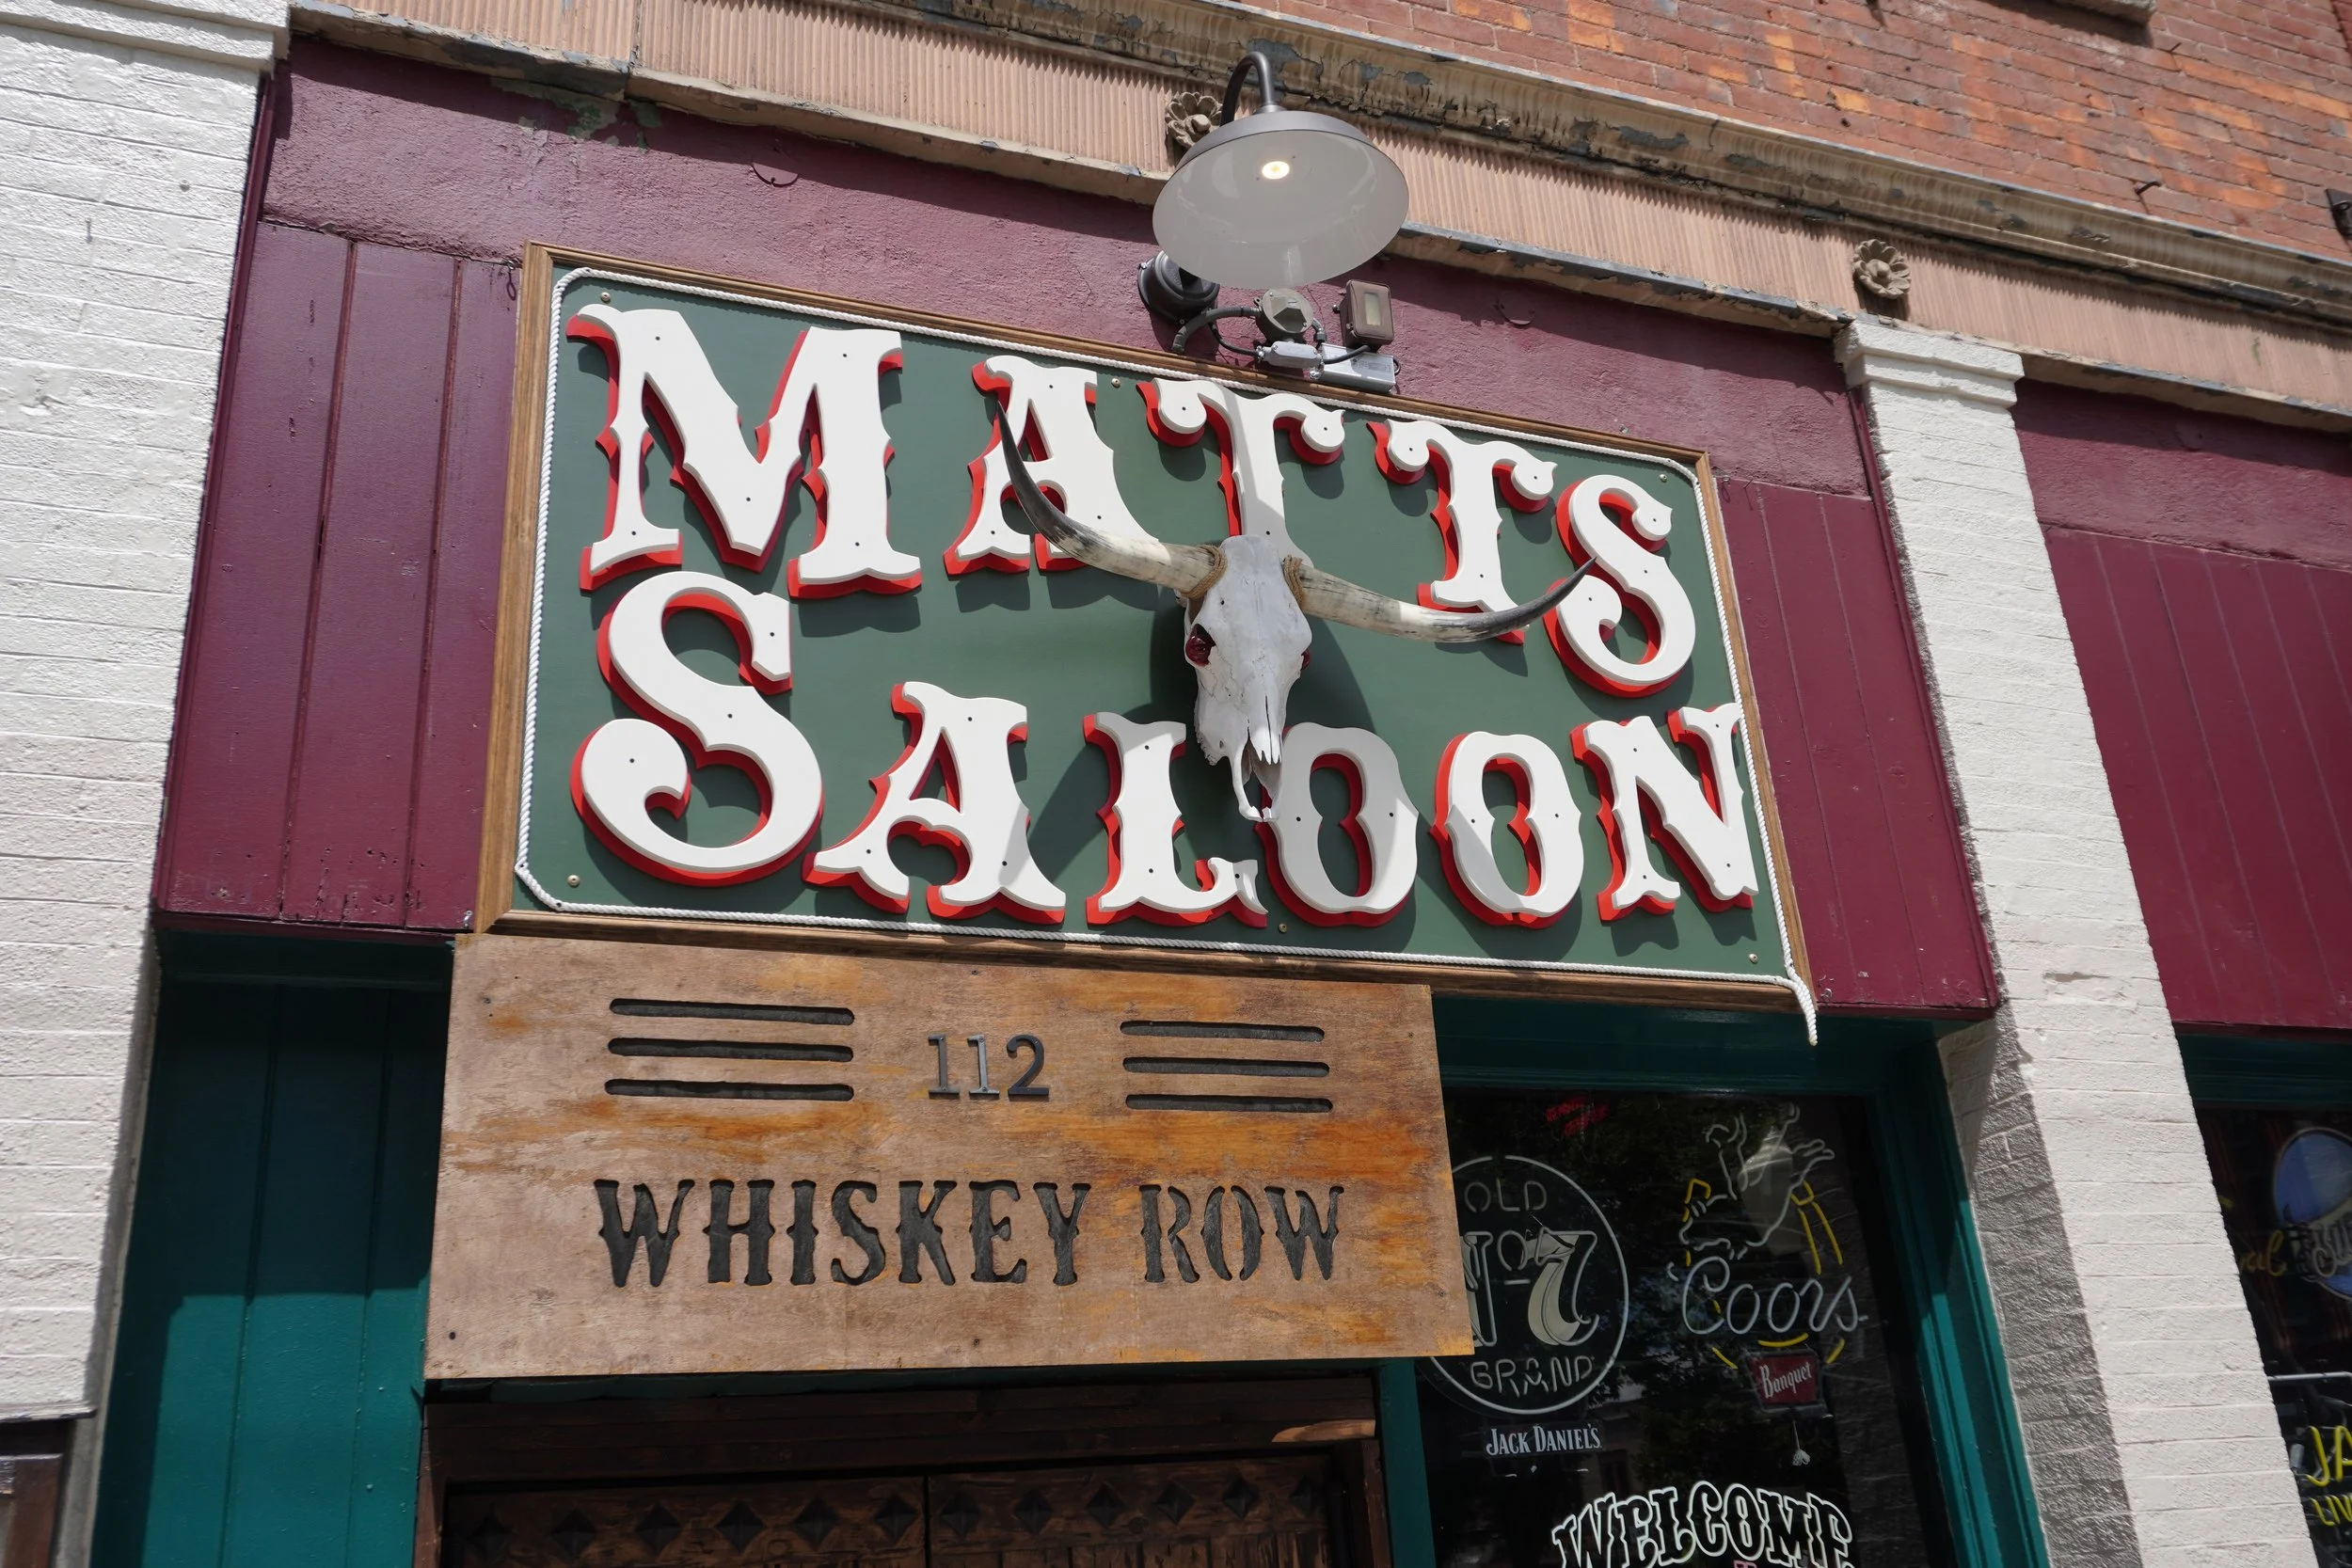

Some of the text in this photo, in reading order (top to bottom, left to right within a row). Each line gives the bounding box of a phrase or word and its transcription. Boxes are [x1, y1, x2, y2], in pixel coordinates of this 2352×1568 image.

[566, 303, 1696, 699] MATTS
[569, 570, 1759, 929] SALOON
[928, 1033, 1051, 1100] 112
[593, 1178, 1344, 1288] WHISKEY ROW
[1464, 1178, 1549, 1212] OLD
[1681, 1256, 1869, 1335] Coors
[1758, 1360, 1814, 1400] Banquet
[1486, 1422, 1602, 1456] JACK DANIEL'S
[1551, 1480, 1859, 1568] WELCOME
